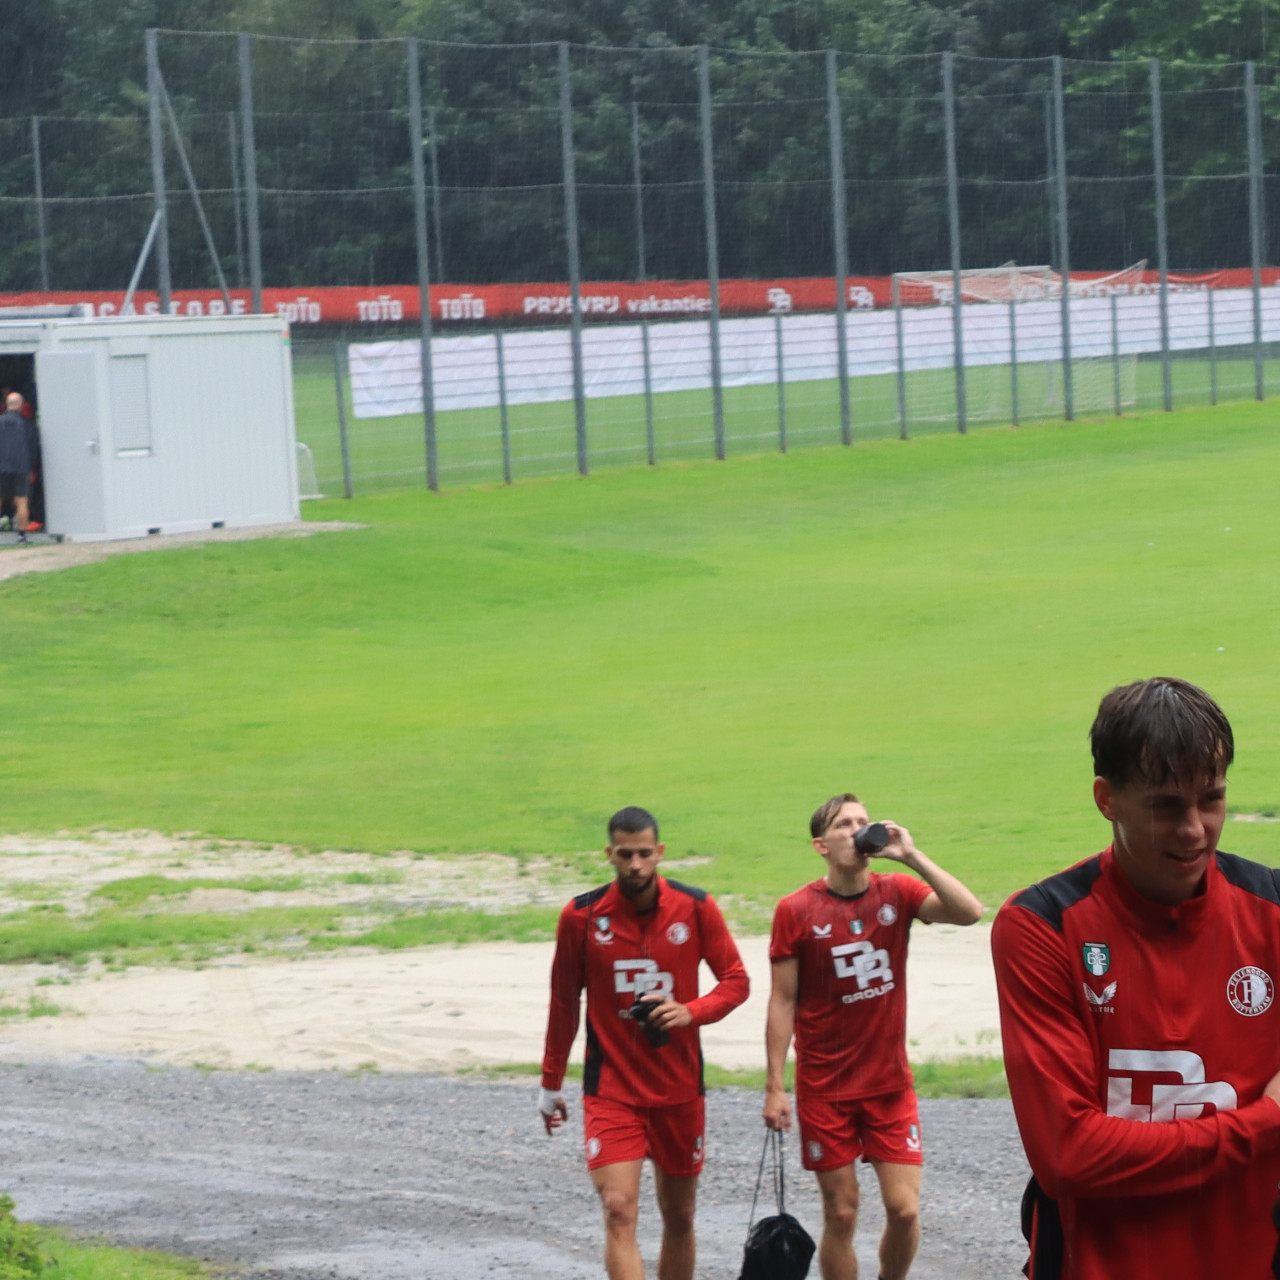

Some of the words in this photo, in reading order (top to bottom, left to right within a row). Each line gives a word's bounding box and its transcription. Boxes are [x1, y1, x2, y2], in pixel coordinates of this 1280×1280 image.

[357, 295, 403, 320] TOTO
[439, 293, 485, 319] TOTO
[1087, 952, 1107, 966] 62
[842, 982, 895, 1004] GROUP
